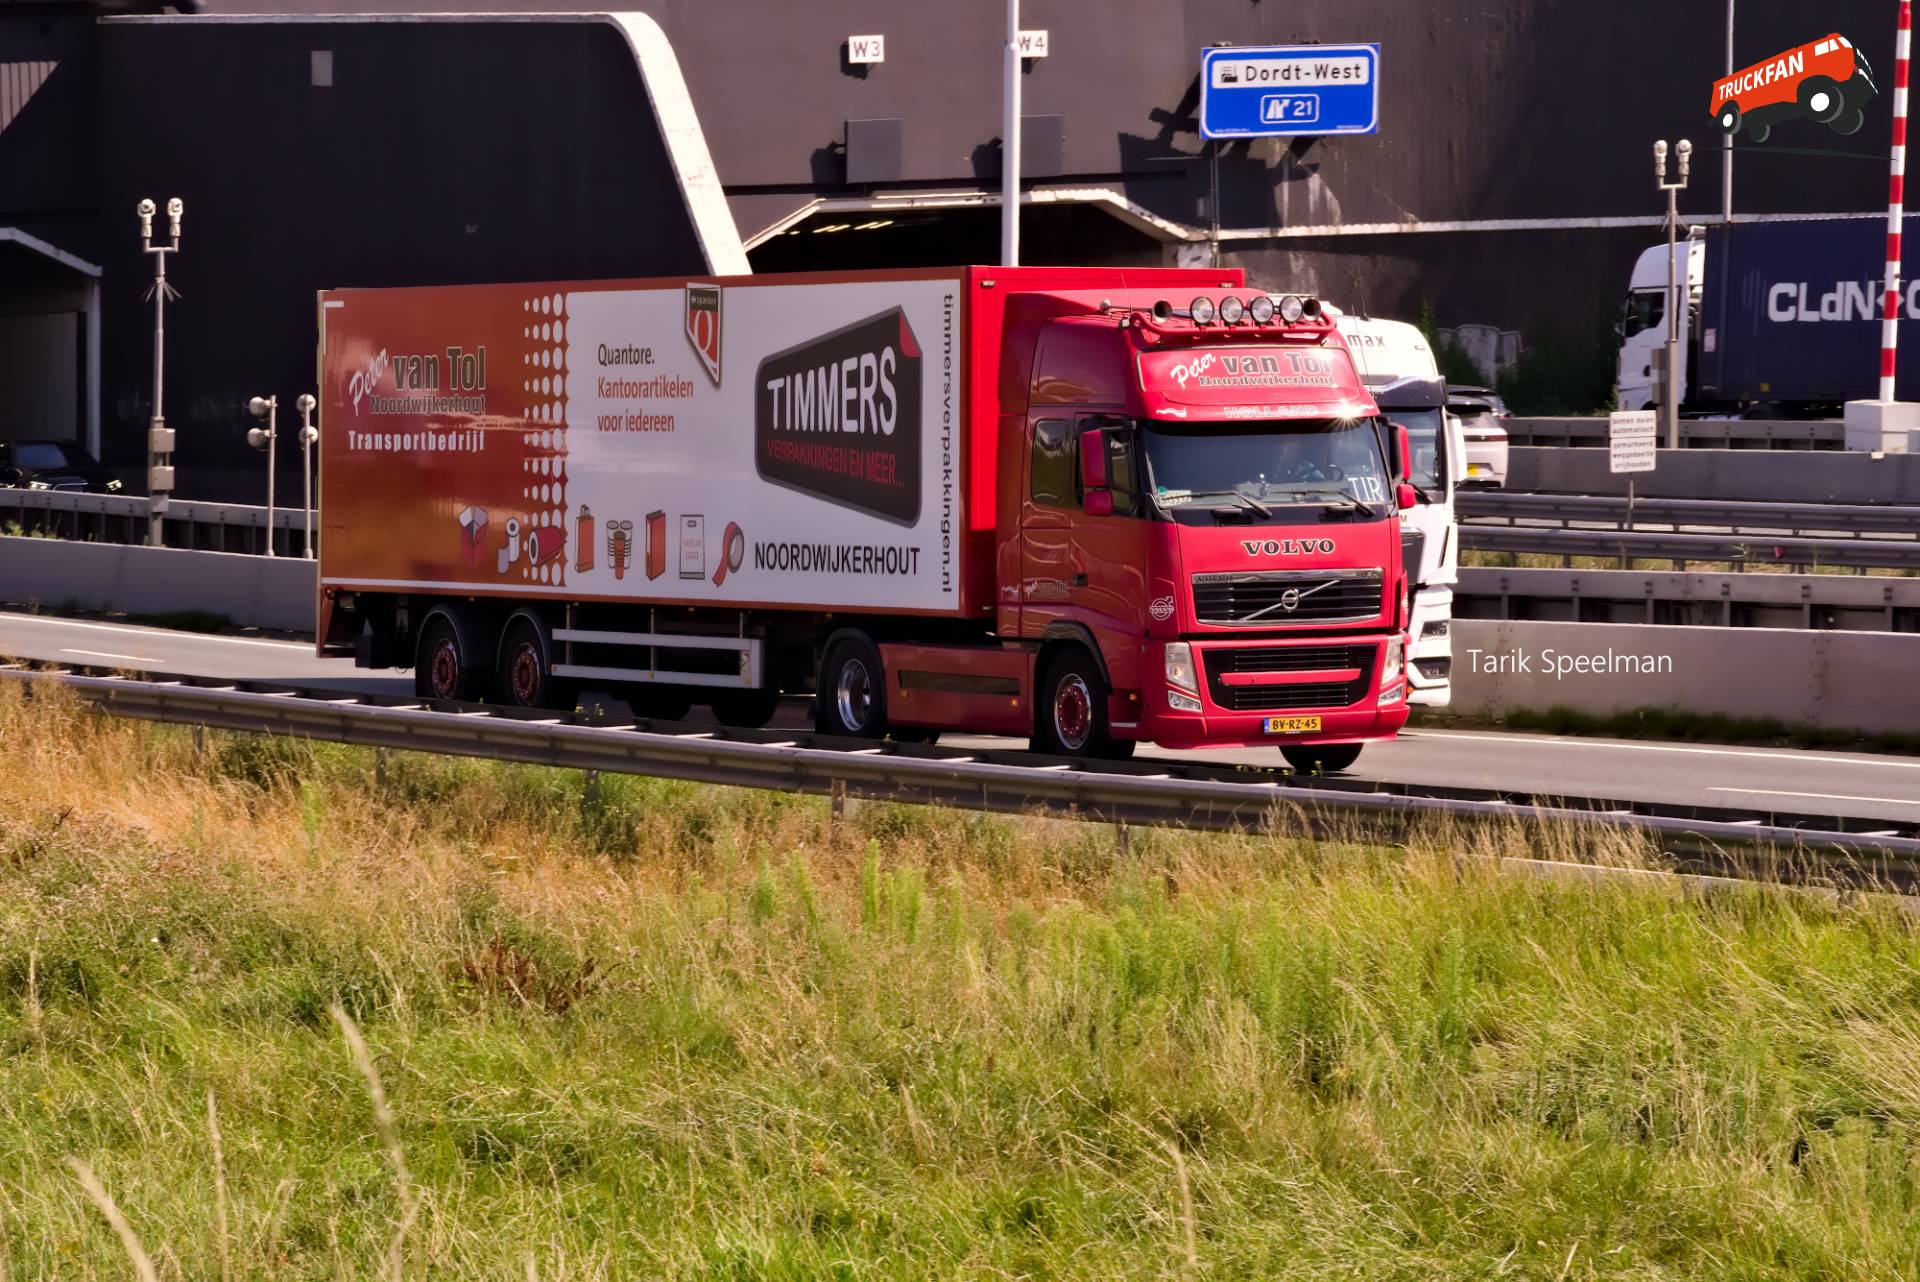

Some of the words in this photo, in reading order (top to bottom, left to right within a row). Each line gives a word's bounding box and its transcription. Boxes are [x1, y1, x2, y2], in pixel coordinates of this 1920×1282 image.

[853, 41, 881, 58] W3
[1018, 36, 1045, 52] W4
[1245, 63, 1362, 82] Dordt-West
[1293, 100, 1313, 117] 21
[1767, 280, 1876, 322] CLdN
[598, 343, 655, 367] Quantore.
[349, 347, 389, 417] Peter
[392, 354, 440, 391] van
[446, 345, 486, 391] Tol
[1169, 352, 1217, 389] Peter
[1221, 355, 1281, 375] van
[1286, 351, 1333, 375] Tol
[598, 374, 694, 399] Kantoorartikelen
[767, 346, 897, 435] TIMMERS
[370, 394, 487, 416] Noordwijkerhout
[597, 415, 623, 432] voor
[625, 408, 675, 432] iedereen
[348, 430, 486, 453] Transportbedrijf
[941, 293, 953, 593] timmersverpakkingen.nl
[767, 440, 848, 473] VERPAKKINGEN
[849, 451, 864, 478] EN
[1347, 476, 1385, 502] TIR
[755, 542, 921, 576] NOORDWIJKERHOUT
[1241, 538, 1336, 556] VOLVO
[1272, 719, 1318, 730] BV-RZ-45
